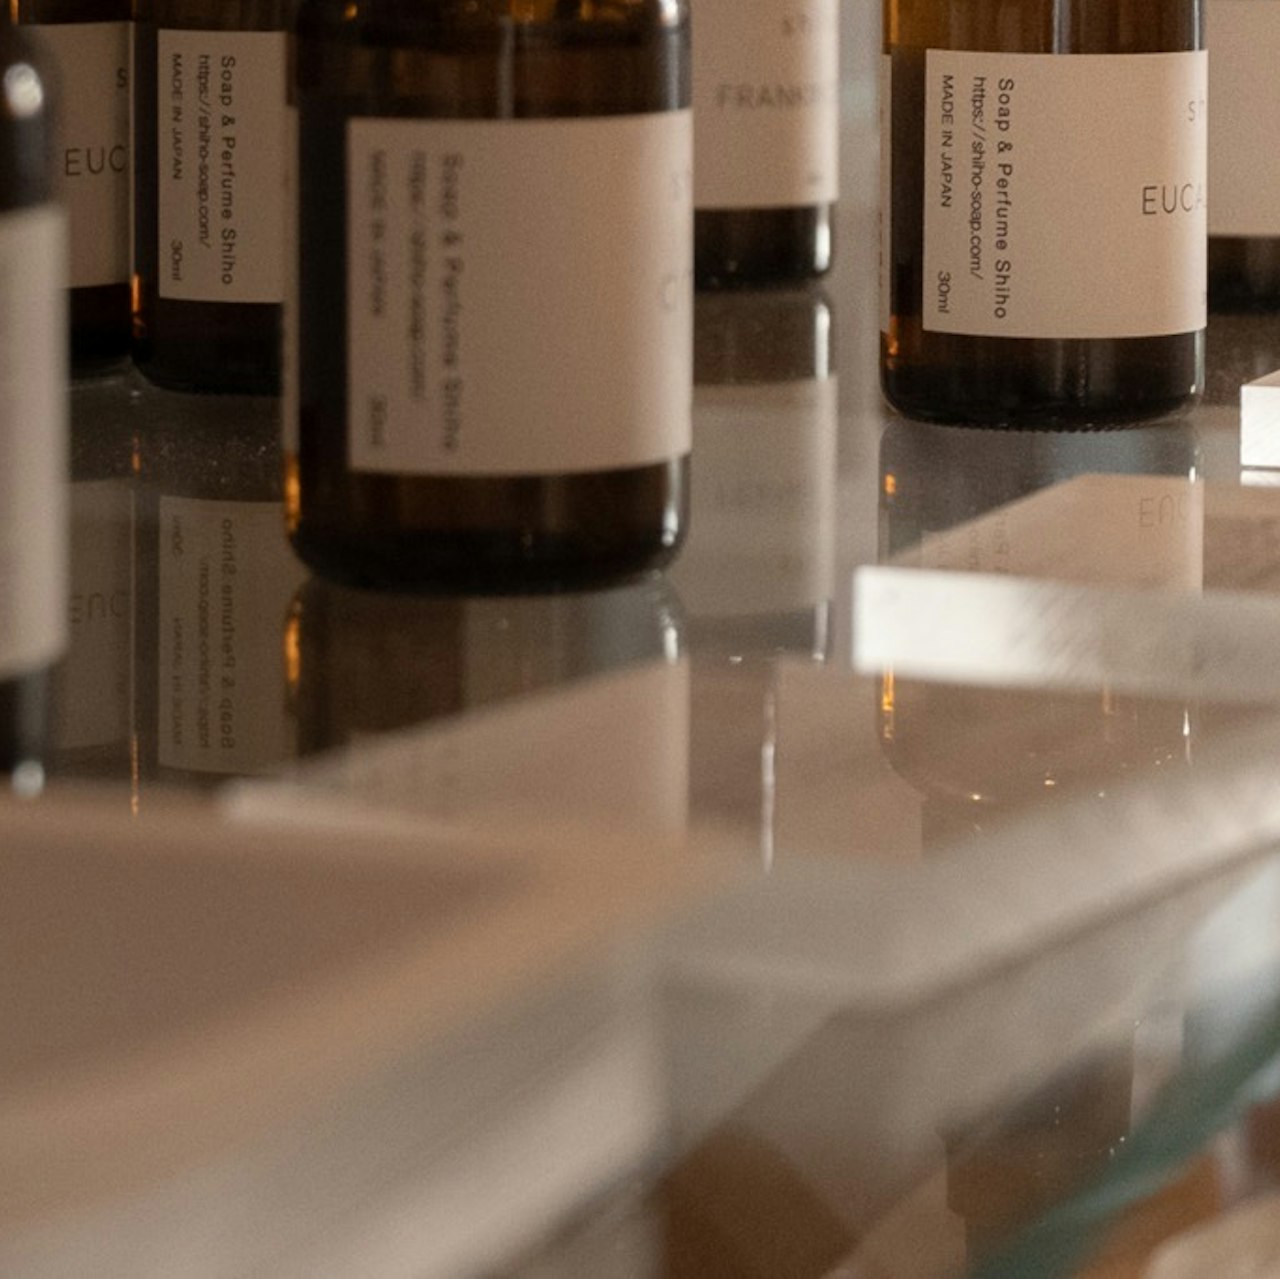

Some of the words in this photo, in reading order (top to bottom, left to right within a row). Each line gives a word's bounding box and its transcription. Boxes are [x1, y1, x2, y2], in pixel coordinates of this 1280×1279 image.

[170, 52, 184, 101] MADE
[219, 55, 237, 108] Soap
[941, 74, 954, 125] MADE
[171, 105, 184, 122] IN
[221, 114, 236, 128] &
[994, 77, 1015, 132] Soap
[64, 145, 127, 177] EUC
[171, 126, 184, 181] JAPAN
[940, 130, 953, 148] IN
[997, 140, 1014, 154] &
[221, 135, 236, 220] Perfume
[939, 152, 953, 208] JAPAN
[969, 76, 987, 280] https://shiho-soap.com/
[995, 163, 1013, 251] Perfume
[221, 227, 238, 286] Shiho
[937, 271, 951, 314] 30ml
[993, 259, 1012, 319] Shiho
